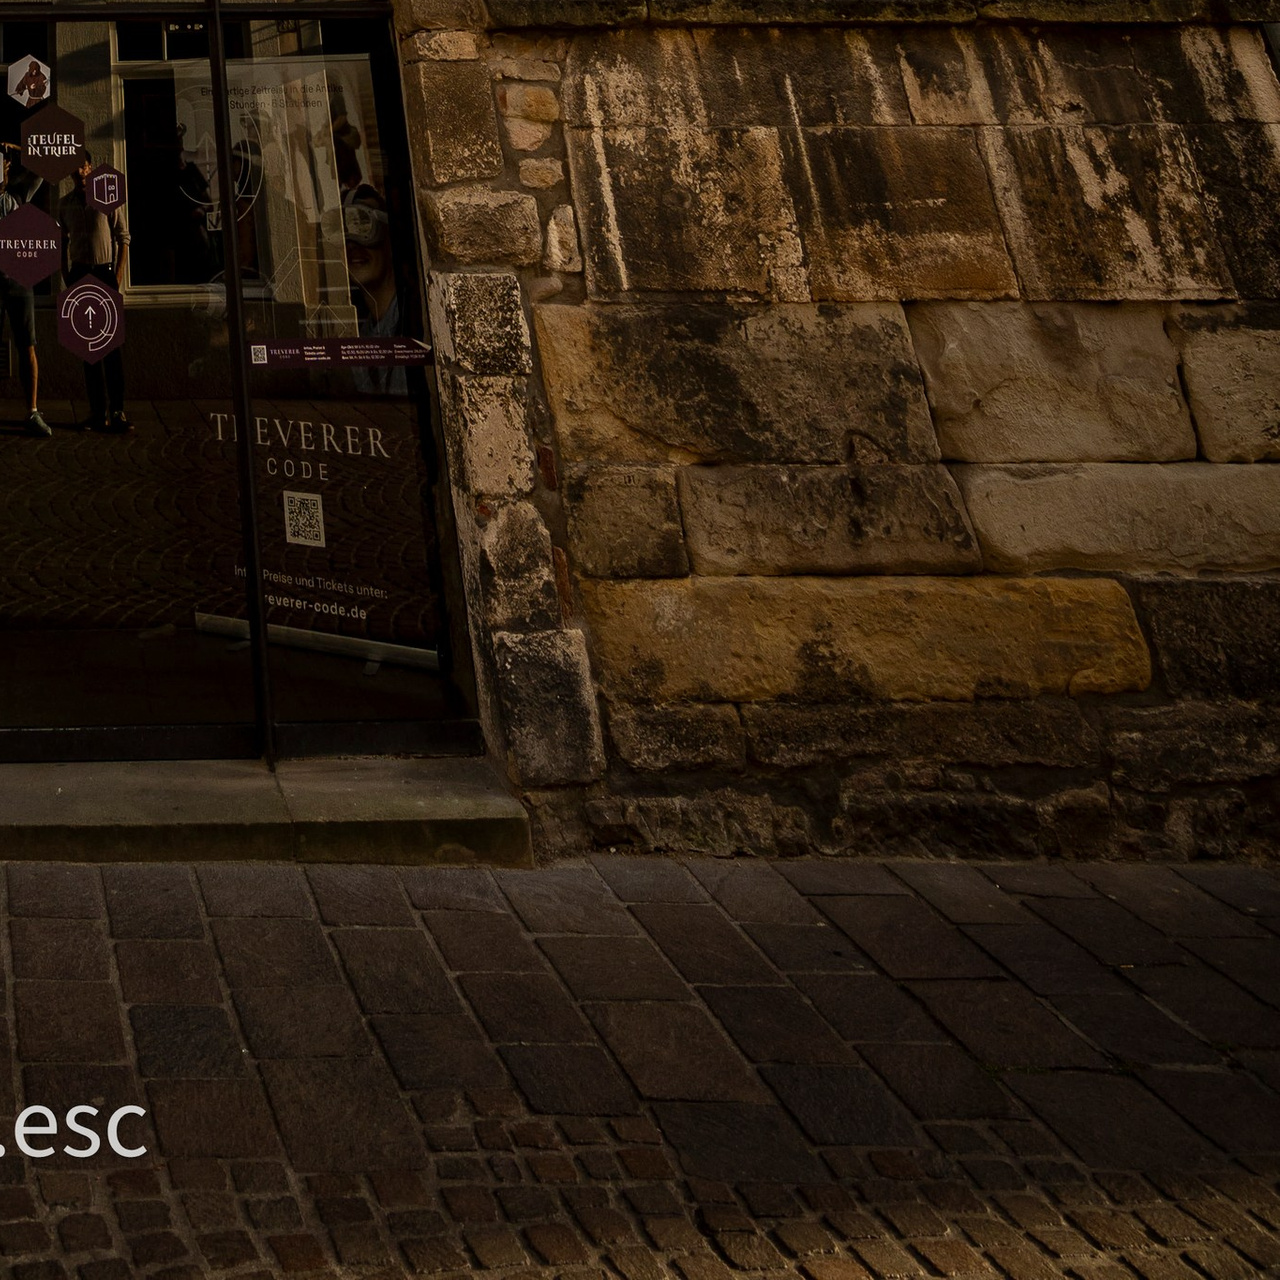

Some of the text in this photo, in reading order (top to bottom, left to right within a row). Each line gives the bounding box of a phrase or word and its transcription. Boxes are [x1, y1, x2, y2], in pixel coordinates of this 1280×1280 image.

[230, 100, 266, 110] Stunden
[30, 132, 82, 148] TEUFEL
[28, 143, 76, 157] IN TRIER
[0, 239, 57, 249] TREVERER
[266, 457, 329, 481] CODE
[263, 569, 293, 585] Preise
[295, 574, 315, 588] und
[315, 576, 354, 594] Tickets
[356, 584, 389, 599] unter:
[264, 593, 367, 620] reverer-code.de
